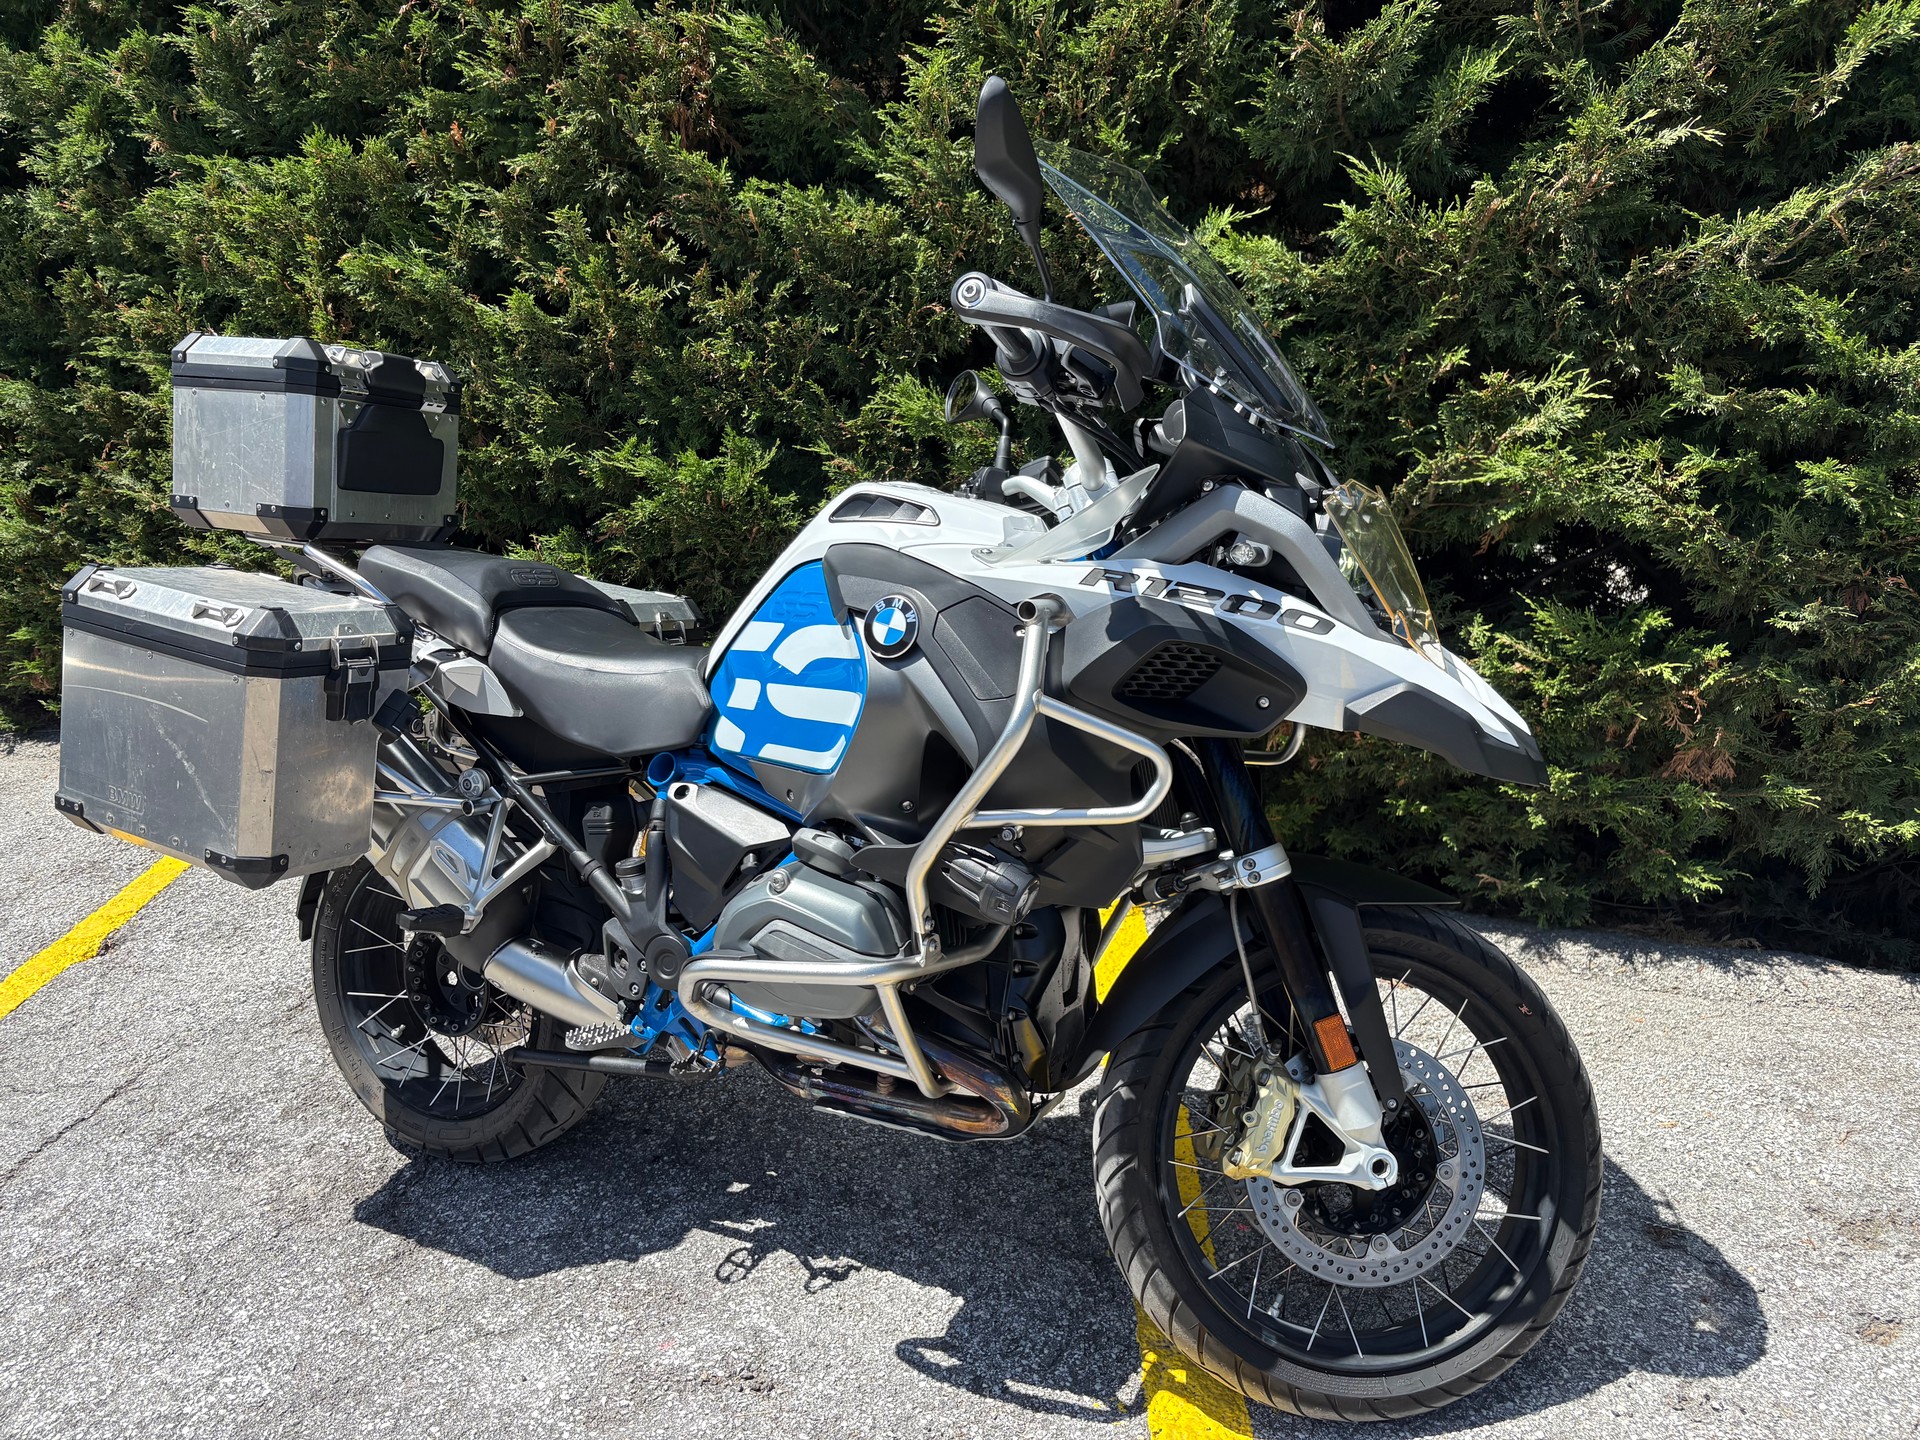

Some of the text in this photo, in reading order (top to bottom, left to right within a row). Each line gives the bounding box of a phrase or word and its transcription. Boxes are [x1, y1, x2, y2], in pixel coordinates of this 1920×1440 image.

[874, 597, 917, 623] BMW
[1079, 567, 1336, 636] R1200
[108, 784, 142, 810] BMW
[1255, 1098, 1284, 1154] brembo
